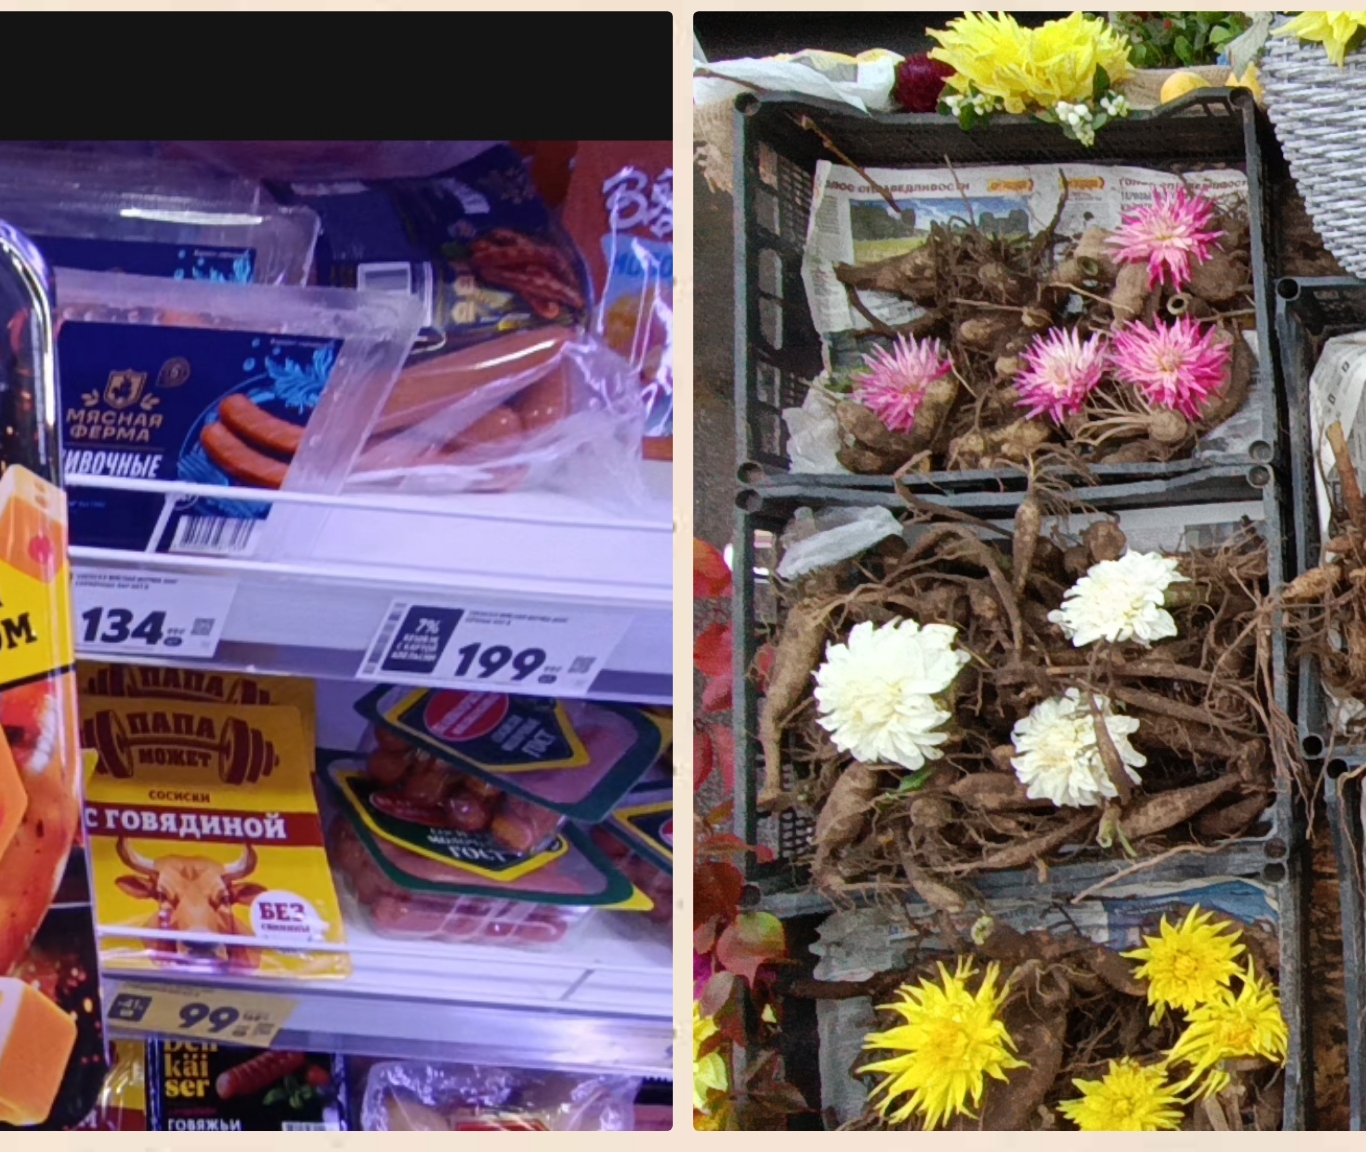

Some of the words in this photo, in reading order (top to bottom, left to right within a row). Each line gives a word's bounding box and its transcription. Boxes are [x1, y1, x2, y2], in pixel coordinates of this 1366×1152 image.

[66, 408, 163, 429] МЯСНАЯ
[69, 423, 151, 443] ФЕРМА
[62, 449, 163, 479] ИВОЧНЫЕ
[81, 606, 167, 645] 134
[454, 642, 547, 681] 199
[136, 665, 224, 697] ПАПА
[126, 711, 217, 741] ПАПА
[138, 748, 213, 768] МОЖЕТ
[148, 790, 211, 804] СОСИСКИ
[104, 808, 288, 840] ГОВЯДИНОЙ
[258, 901, 306, 922] БЕЗ
[179, 1003, 239, 1033] 99
[165, 1052, 209, 1078] käi
[165, 1078, 210, 1098] ser
